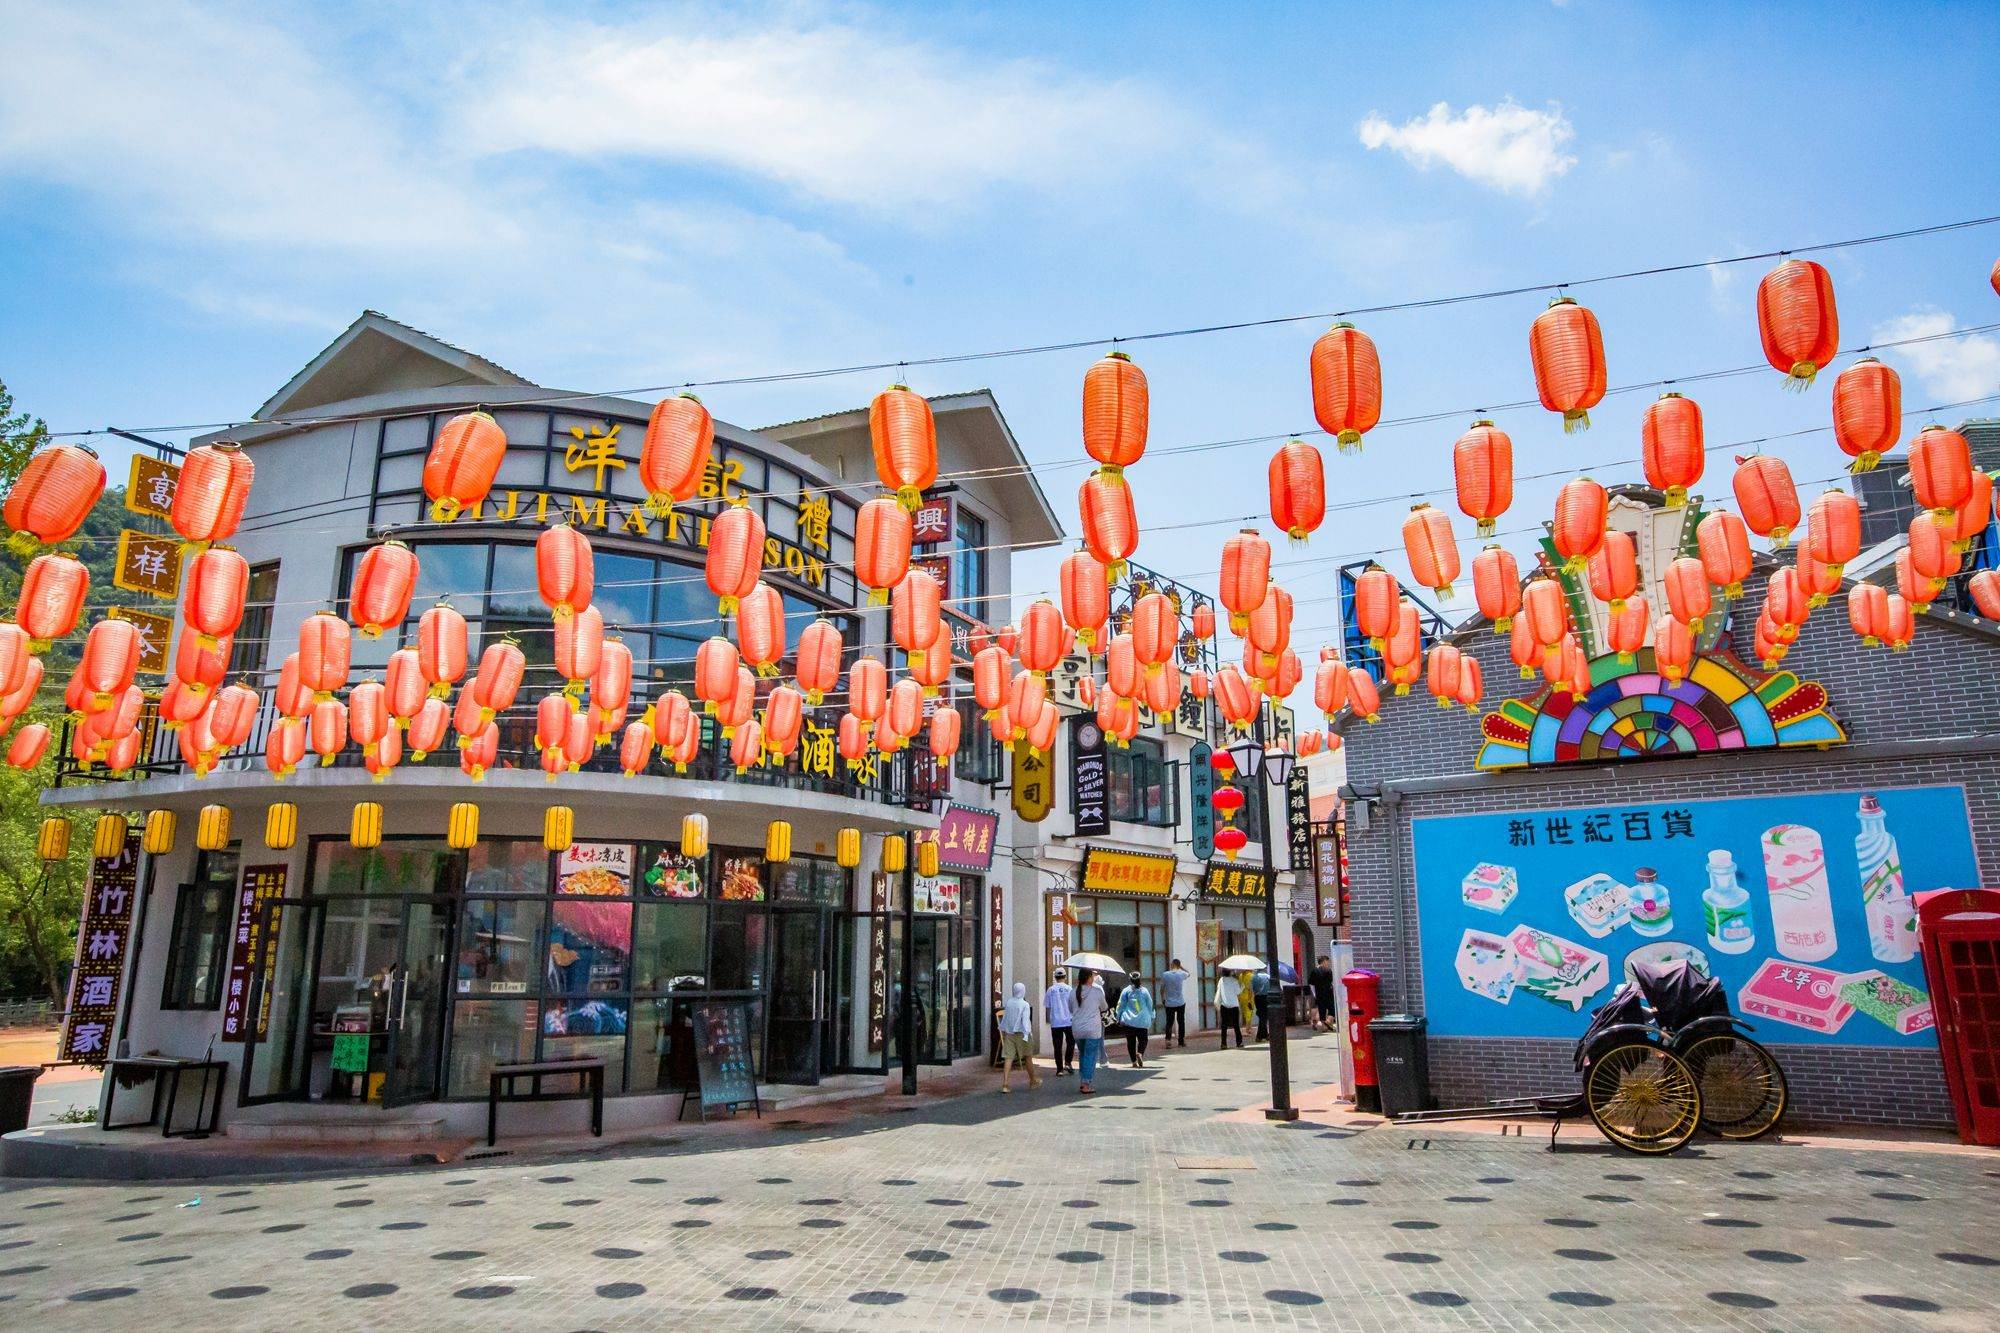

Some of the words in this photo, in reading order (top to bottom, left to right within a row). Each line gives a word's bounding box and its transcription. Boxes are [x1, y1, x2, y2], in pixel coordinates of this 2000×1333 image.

[1077, 761, 1103, 775] DIAMONDS
[1084, 778, 1104, 792] SILVER
[1080, 790, 1103, 800] WATCHES
[1508, 808, 1696, 847] 新世紀百貨
